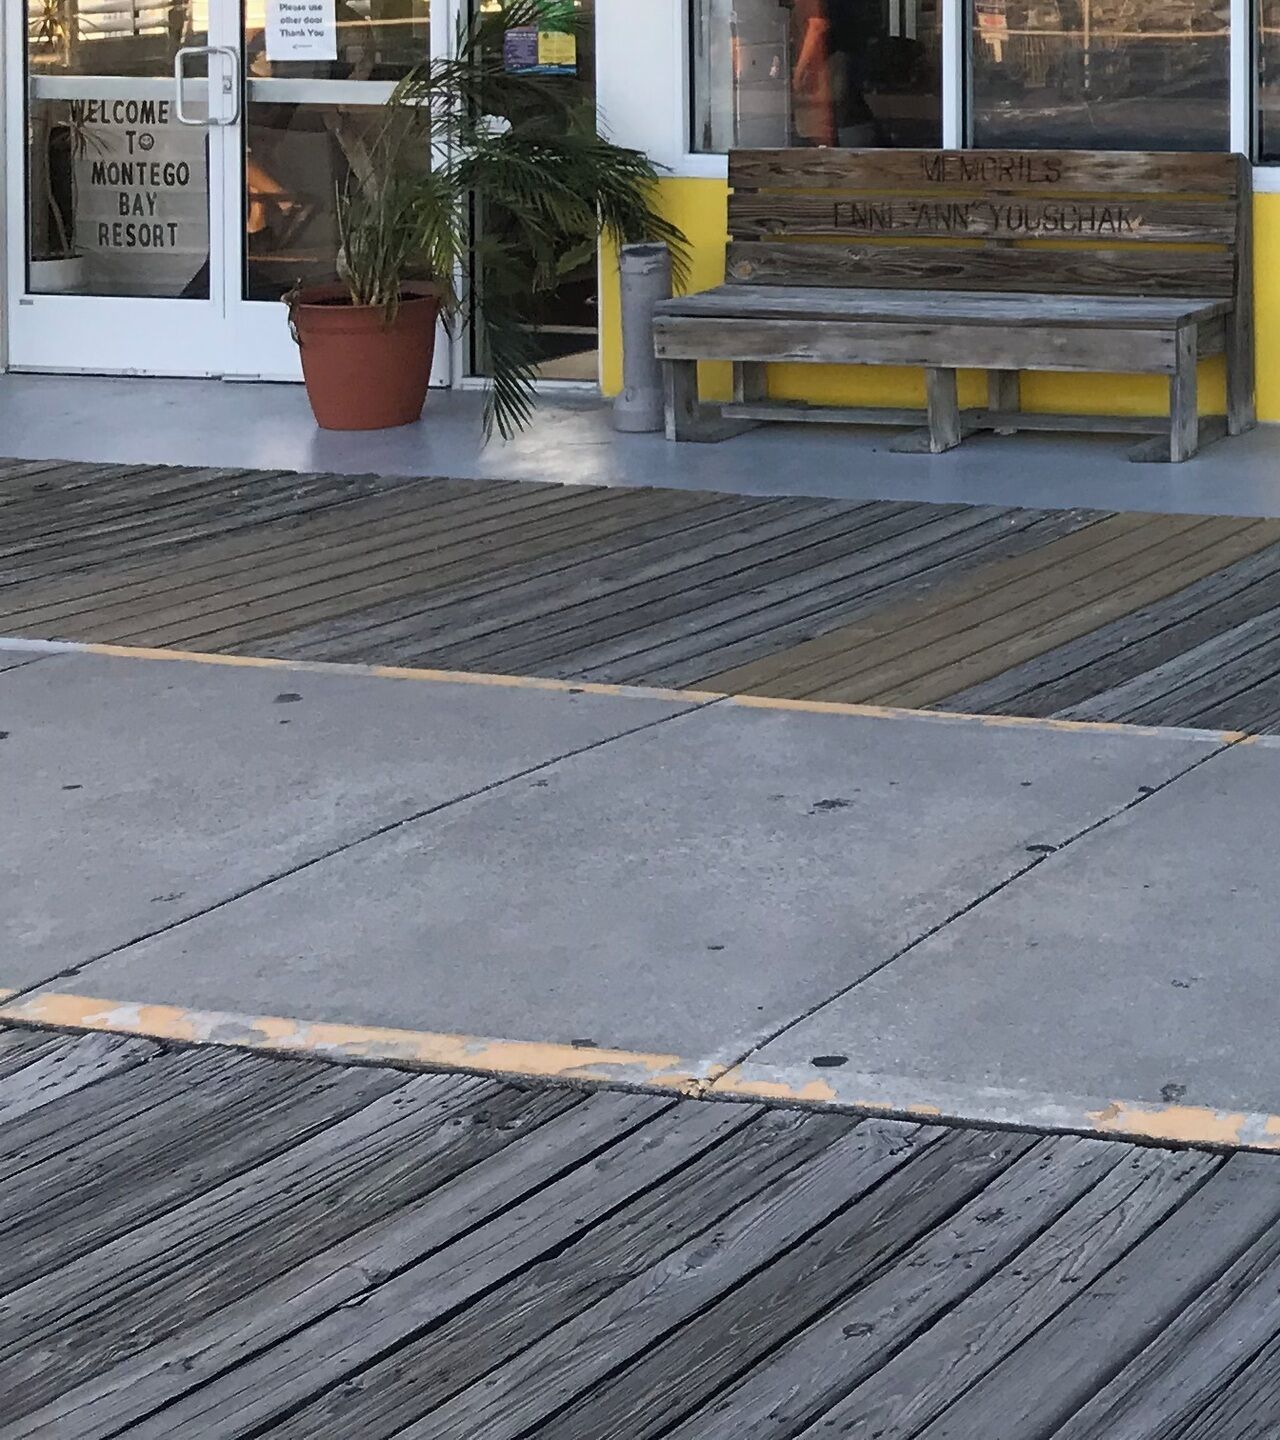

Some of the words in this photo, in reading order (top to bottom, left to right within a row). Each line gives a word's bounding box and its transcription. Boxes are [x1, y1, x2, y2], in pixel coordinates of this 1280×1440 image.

[279, 3, 306, 11] Please
[280, 16, 302, 24] other
[304, 16, 322, 24] door
[279, 29, 305, 37] Thank
[308, 29, 324, 37] You
[70, 99, 169, 124] WELCOME
[92, 161, 190, 186] MONTEGO
[119, 192, 157, 216] BAY
[98, 223, 178, 247] RESORT
